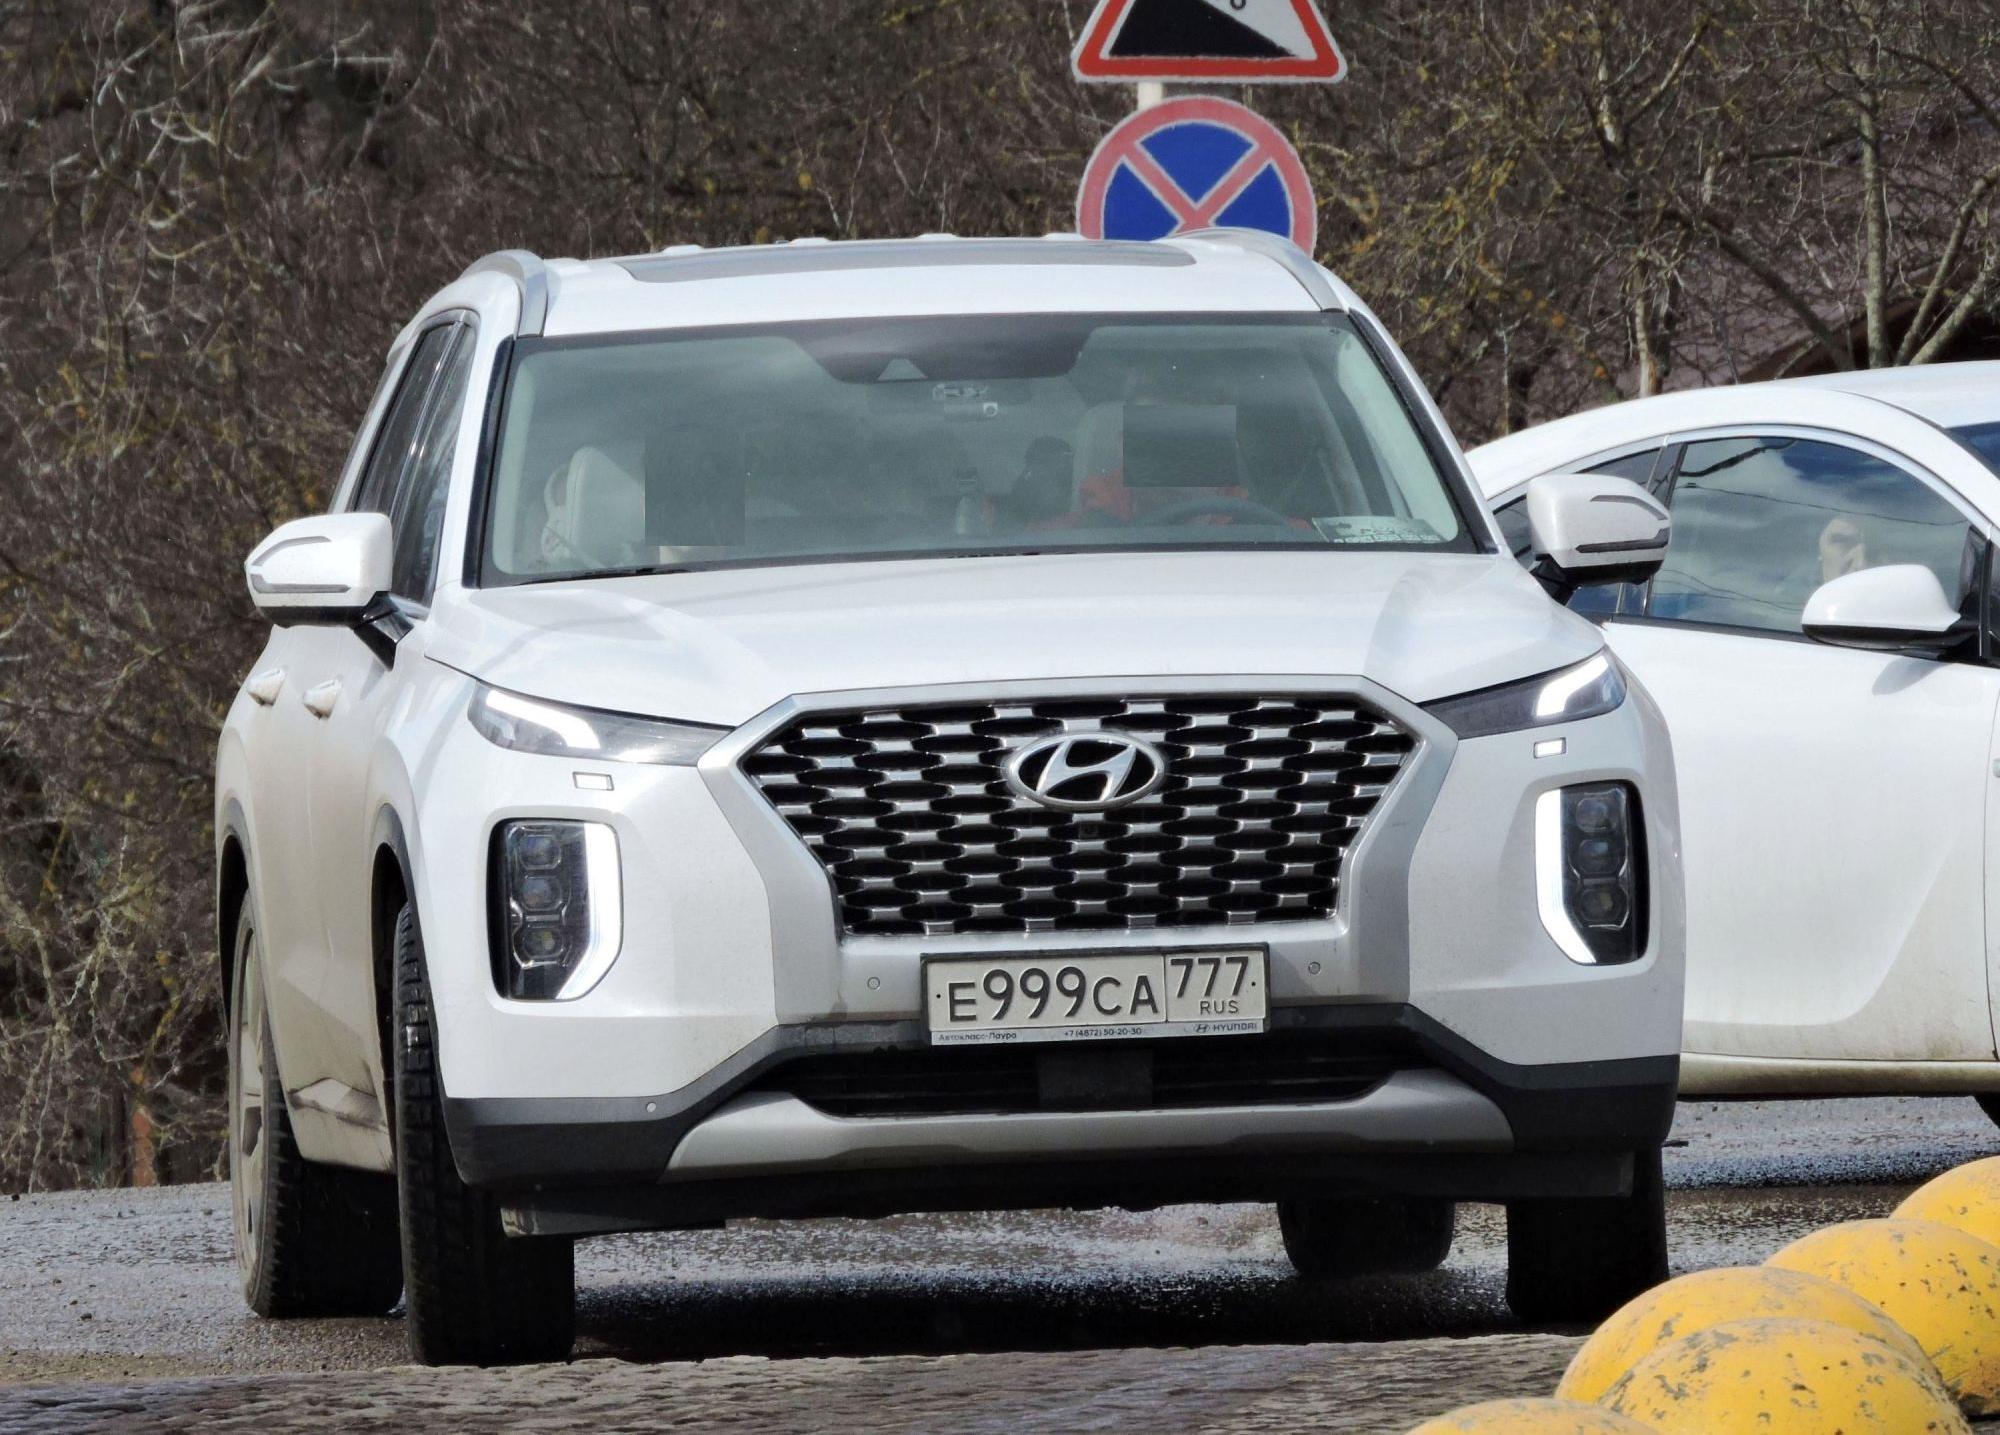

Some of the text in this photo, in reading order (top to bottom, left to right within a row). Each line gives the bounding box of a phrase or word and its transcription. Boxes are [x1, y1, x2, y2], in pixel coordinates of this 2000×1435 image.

[1170, 956, 1249, 998] 777
[1199, 1000, 1240, 1015] RUS
[1103, 1027, 1142, 1036] 50-20-30
[1213, 1022, 1257, 1032] HYUNDAI
